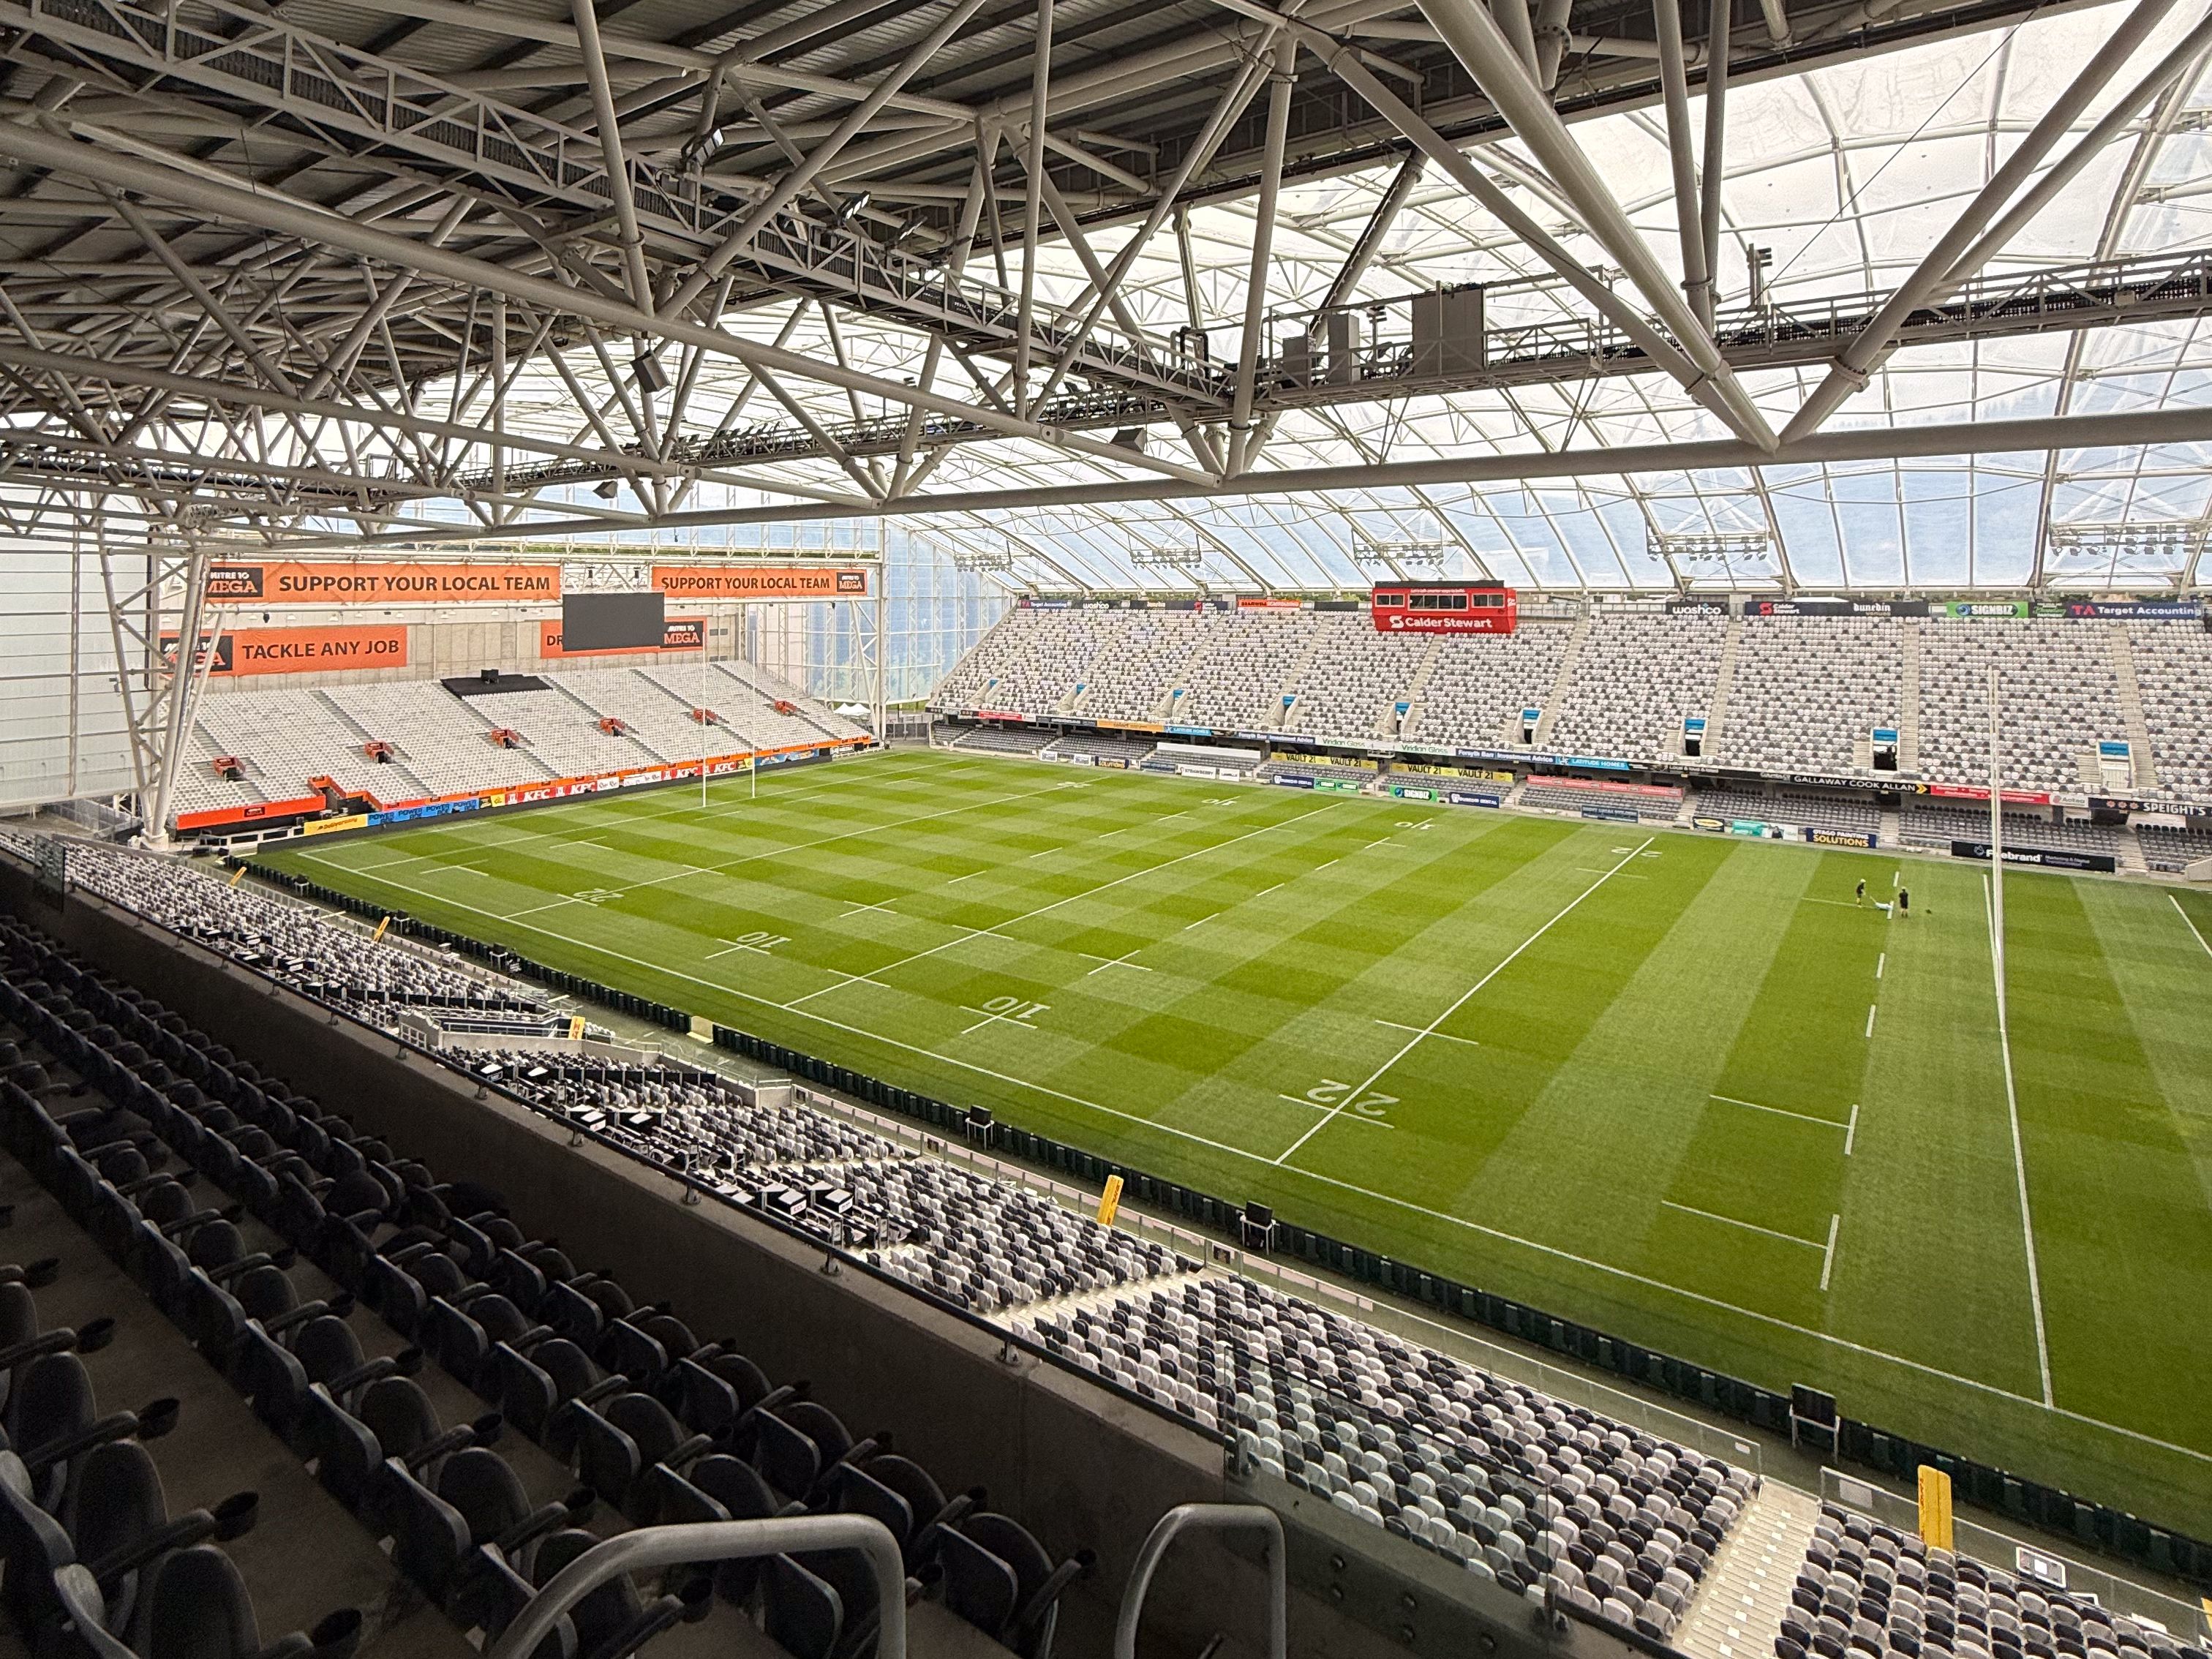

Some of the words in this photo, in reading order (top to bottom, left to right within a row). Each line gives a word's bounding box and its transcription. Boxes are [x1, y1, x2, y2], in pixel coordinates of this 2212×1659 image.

[279, 576, 379, 591] SUPPORT
[384, 576, 437, 591] YOUR
[443, 576, 500, 591] LOCAL
[504, 576, 550, 590] TEAM
[661, 576, 722, 590] SUPPORT
[725, 577, 759, 590] YOUR
[761, 577, 797, 589] LOCAL
[800, 577, 830, 589] TEAM
[839, 580, 862, 590] MEGA
[1971, 605, 2013, 615] SIGNBIZ
[2098, 606, 2133, 616] Target
[2137, 606, 2201, 617] Accounting
[1405, 617, 1442, 628] Calder
[1443, 617, 1493, 628] Stewart
[663, 632, 700, 644] MEGA
[241, 643, 315, 660] TACKLE
[321, 642, 360, 656] ANY
[365, 640, 399, 655] JOB
[1286, 754, 1306, 763] VAULT
[1331, 757, 1352, 767] VAULT
[1353, 759, 1361, 767] 21
[1458, 749, 1481, 758] Forsyth
[1497, 752, 1531, 761] Investment
[1532, 755, 1554, 763] Advice
[714, 761, 736, 773] KFC
[1572, 759, 1600, 767] LATITUDE
[1601, 760, 1625, 768] HOMES
[1407, 764, 1432, 774] VAULT
[1433, 766, 1441, 775] 21
[1458, 769, 1482, 778] VAULT
[1485, 772, 1494, 780] 21
[571, 781, 596, 795] KFC
[1794, 775, 1848, 786] GALLAWAY
[1849, 780, 1880, 789] COOK
[1881, 783, 1916, 791] ALLAN
[523, 789, 551, 802] KFC
[398, 808, 423, 816] POWER
[426, 803, 450, 812] POWER
[2143, 802, 2206, 816] SPEIGHT'S
[1813, 828, 1836, 837] OTAGO
[1836, 830, 1869, 840] PAINTING
[1813, 835, 1870, 848] SOLUTIONS
[1986, 849, 2041, 863] Febrand
[736, 931, 792, 949] 10
[982, 996, 1052, 1019] 10
[1306, 1078, 1401, 1116] 22
